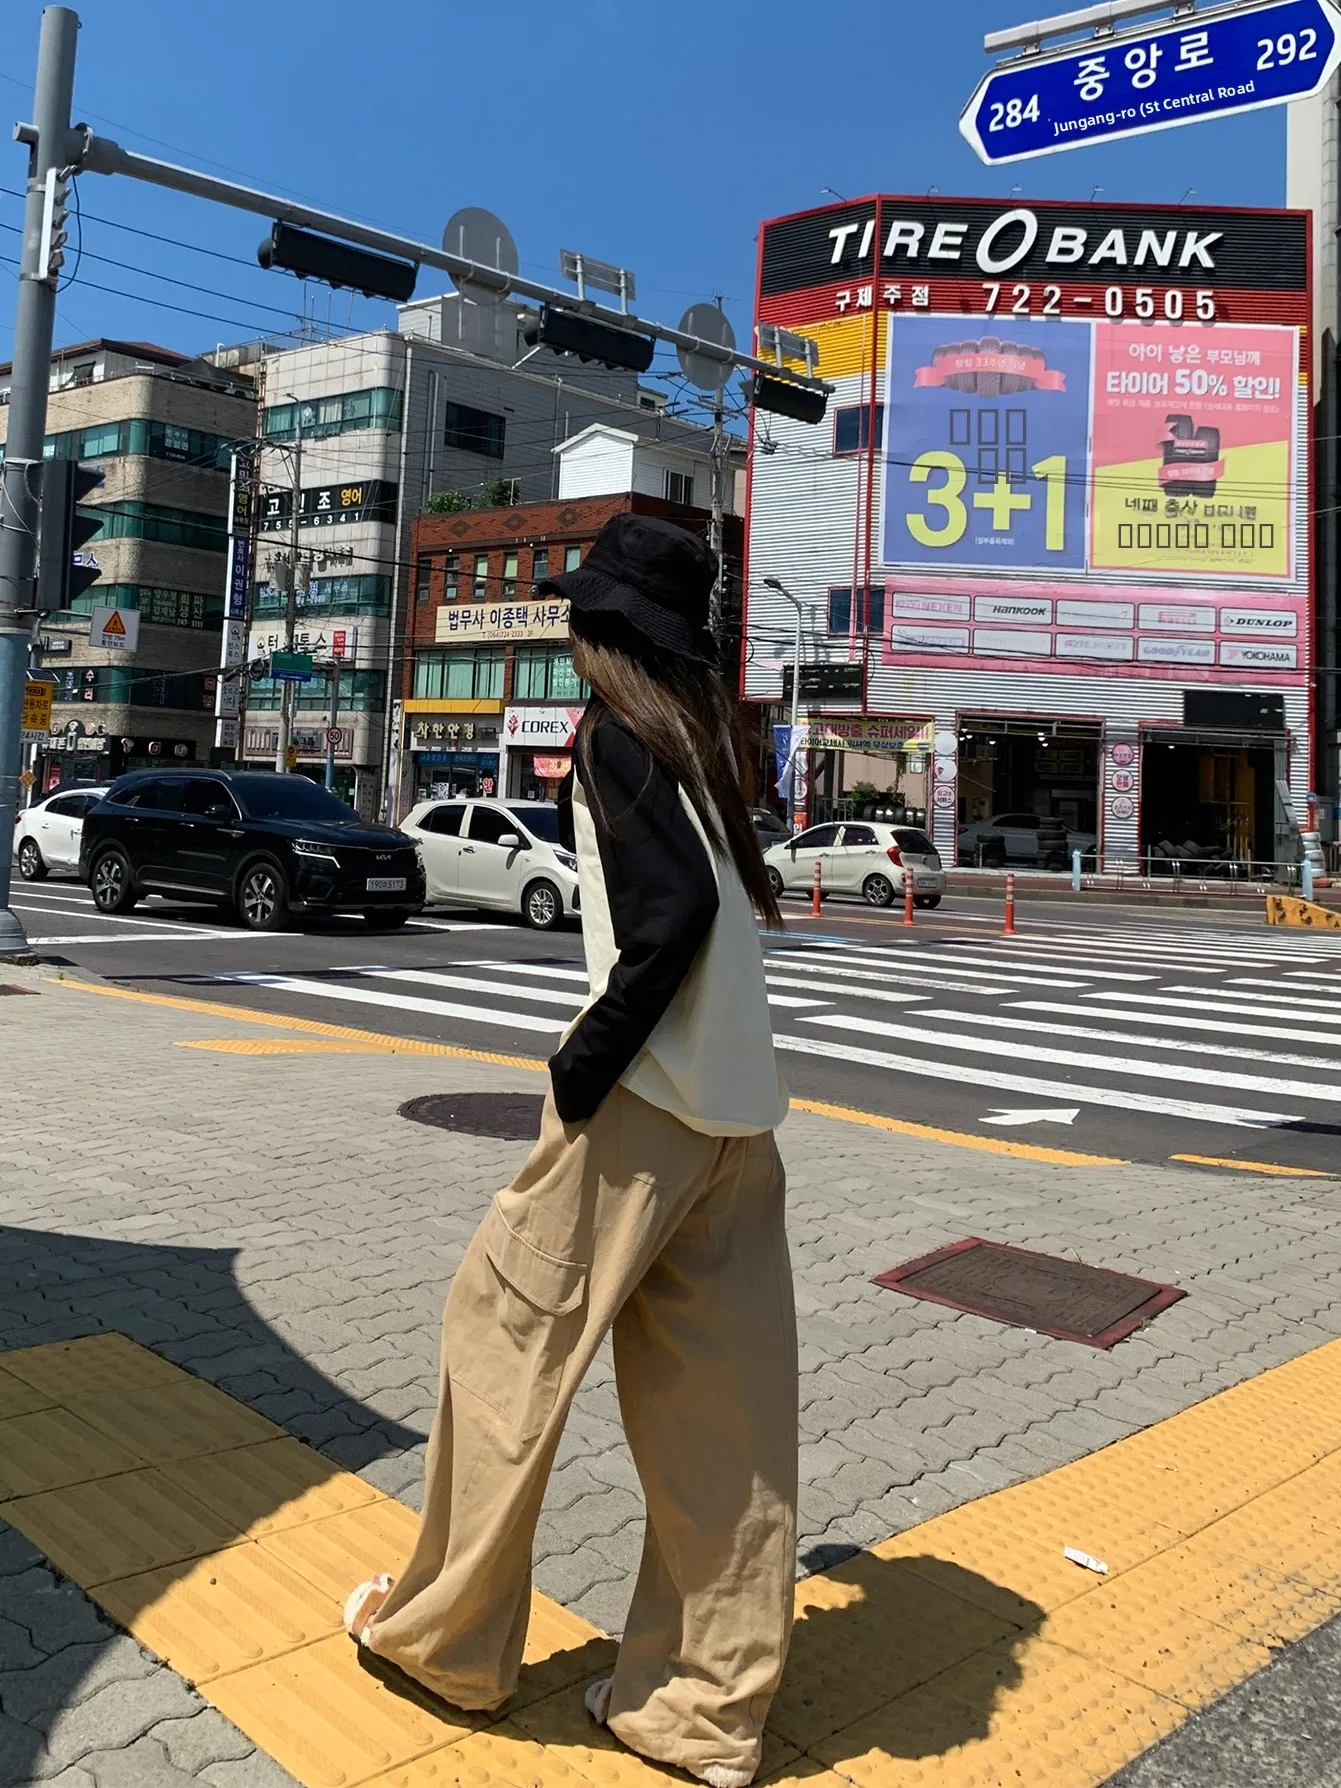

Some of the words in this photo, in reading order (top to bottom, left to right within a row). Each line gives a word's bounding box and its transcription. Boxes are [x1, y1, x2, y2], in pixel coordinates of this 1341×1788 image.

[1256, 28, 1318, 72] 292
[988, 94, 1041, 133] 284
[1053, 106, 1137, 136] Jungang-ro
[1139, 99, 1160, 119] (St
[1162, 87, 1215, 109] Central
[1218, 79, 1255, 99] Road
[982, 283, 1217, 318] 722-0505
[1128, 343, 1162, 363] 아이
[1206, 350, 1261, 367] 부모님께
[1106, 370, 1168, 395] 타이어
[1174, 368, 1228, 397] 50%
[1233, 375, 1281, 401] 할인!
[341, 486, 362, 507] 영어
[906, 450, 1067, 551] 3+1
[448, 608, 485, 631] 법무사
[490, 606, 528, 630] 이종택
[1235, 618, 1293, 628] DUNLOP
[1241, 651, 1290, 663] YOKOHAMA
[329, 731, 339, 741] 50
[521, 719, 569, 734] COREX
